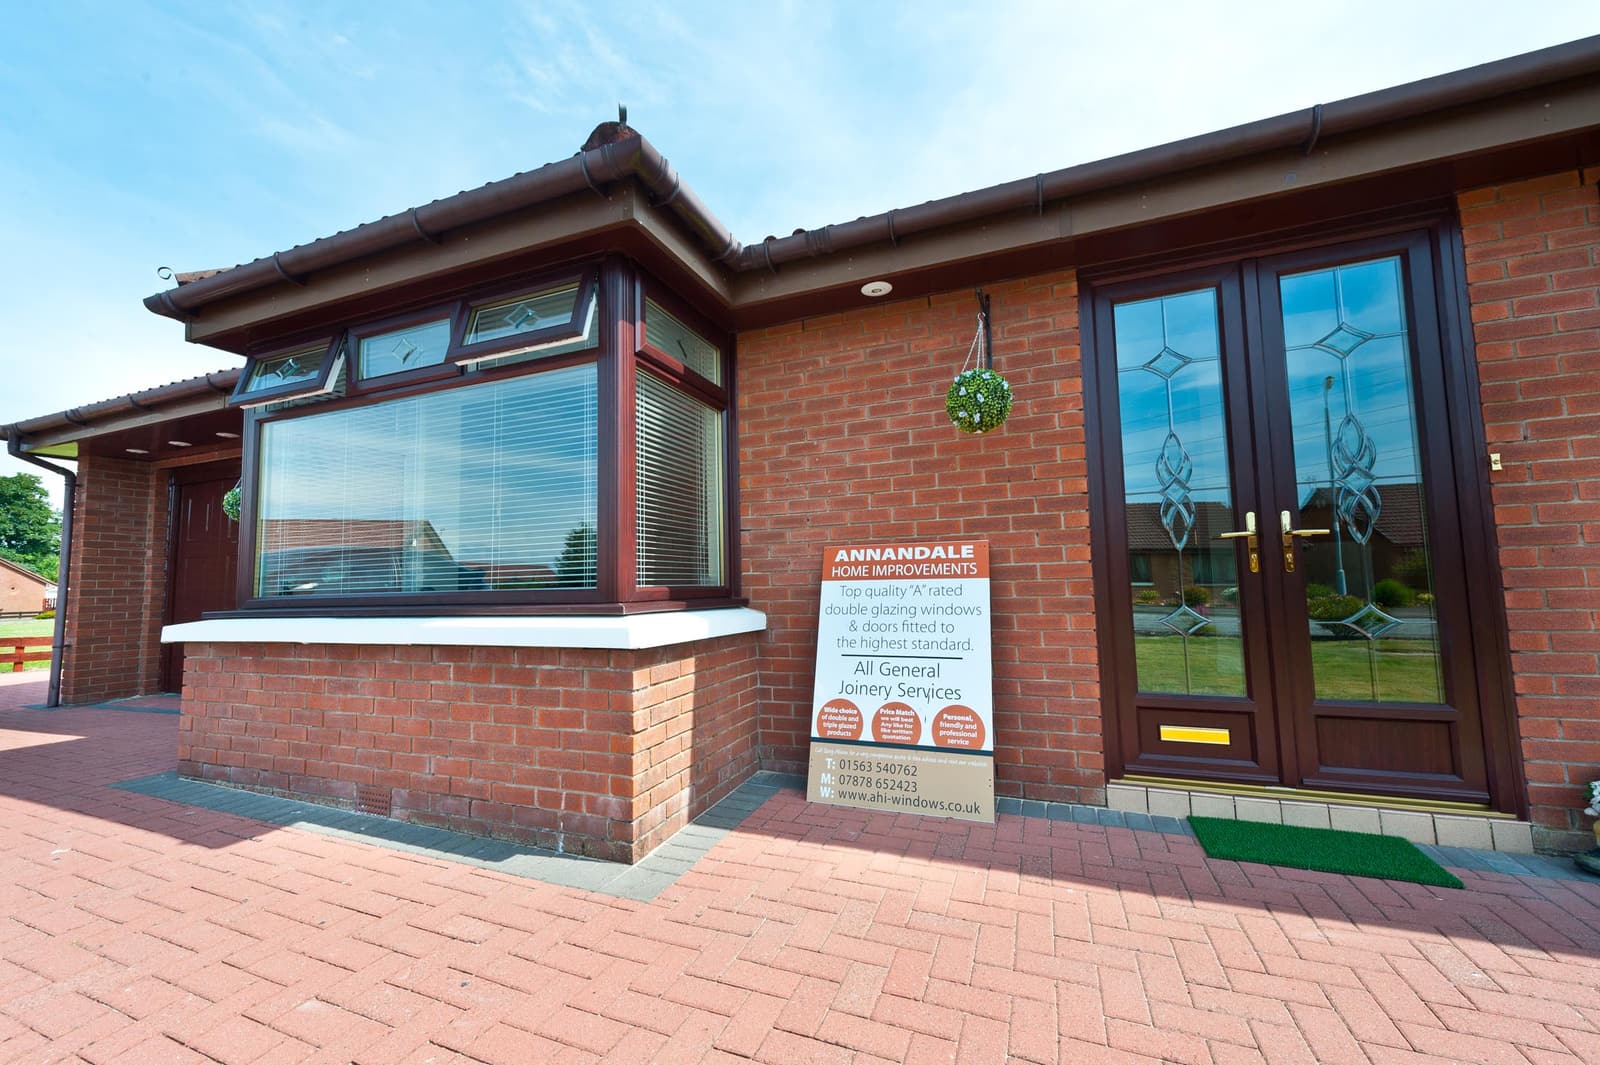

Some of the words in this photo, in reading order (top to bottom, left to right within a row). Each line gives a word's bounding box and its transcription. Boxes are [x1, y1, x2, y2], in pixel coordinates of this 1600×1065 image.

[835, 545, 974, 562] ANNANDALE
[832, 565, 868, 577] HOME
[873, 563, 977, 576] IMPROVEMENTS
[840, 585, 861, 598] Top
[865, 585, 907, 598] quality
[929, 584, 963, 596] rated
[825, 604, 867, 615] double
[871, 604, 917, 618] glazing
[921, 604, 982, 615] windows
[849, 621, 857, 632] &
[862, 620, 898, 632] doors
[902, 621, 936, 633] fitted
[941, 623, 954, 633] to
[837, 637, 856, 648] the
[860, 637, 907, 651] highest
[911, 638, 974, 651] standard.
[854, 661, 873, 675] All
[879, 662, 940, 678] General
[839, 680, 892, 701] Joinery
[898, 683, 961, 700] Services
[940, 721, 963, 730] friendly
[939, 730, 977, 738] professional
[826, 758, 835, 769] T:
[840, 759, 872, 771] 01563
[876, 762, 917, 776] 540762
[821, 774, 834, 785] M:
[839, 775, 872, 787] 07878
[876, 778, 917, 792] 652423
[820, 787, 834, 798] W:
[838, 789, 981, 814] www.ahi-windows.co.uk
